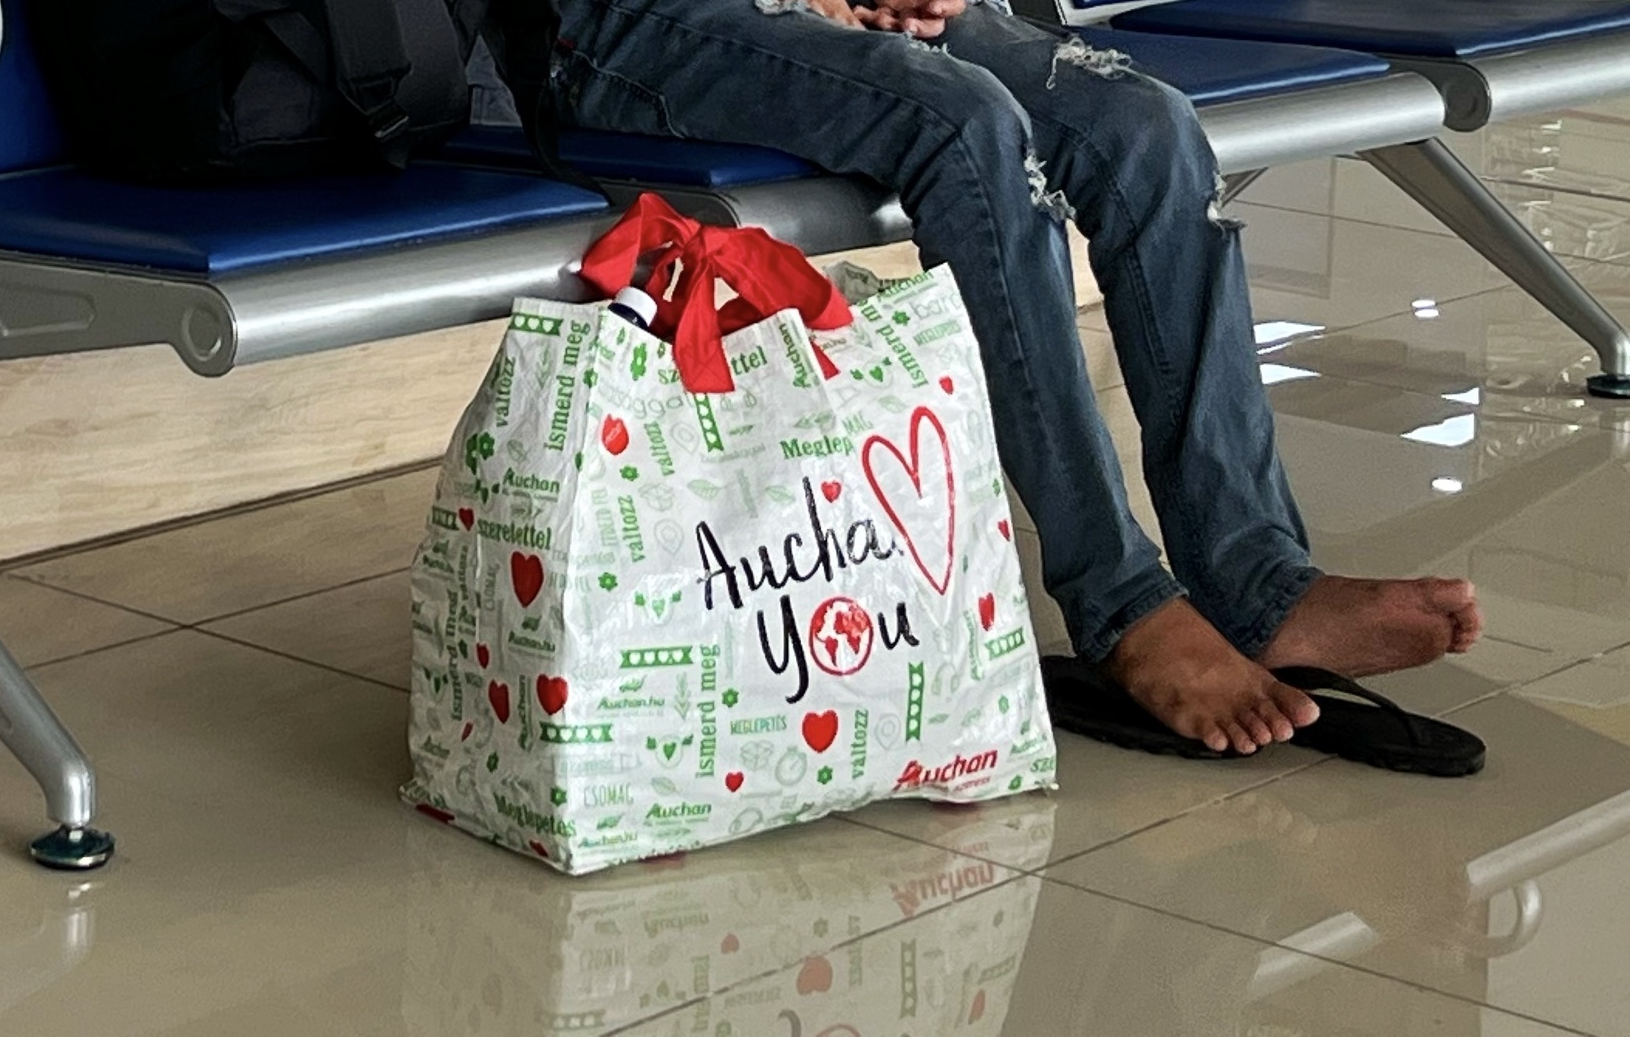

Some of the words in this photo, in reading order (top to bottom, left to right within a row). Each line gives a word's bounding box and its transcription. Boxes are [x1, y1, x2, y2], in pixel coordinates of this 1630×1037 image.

[779, 323, 812, 389] Auchan
[544, 375, 576, 452] ismerd
[563, 320, 591, 366] meg
[501, 467, 560, 494] Auchan
[700, 644, 720, 691] meg
[695, 701, 716, 779] ismerd
[892, 750, 998, 792] Auchan
[645, 801, 712, 822] Auchan
